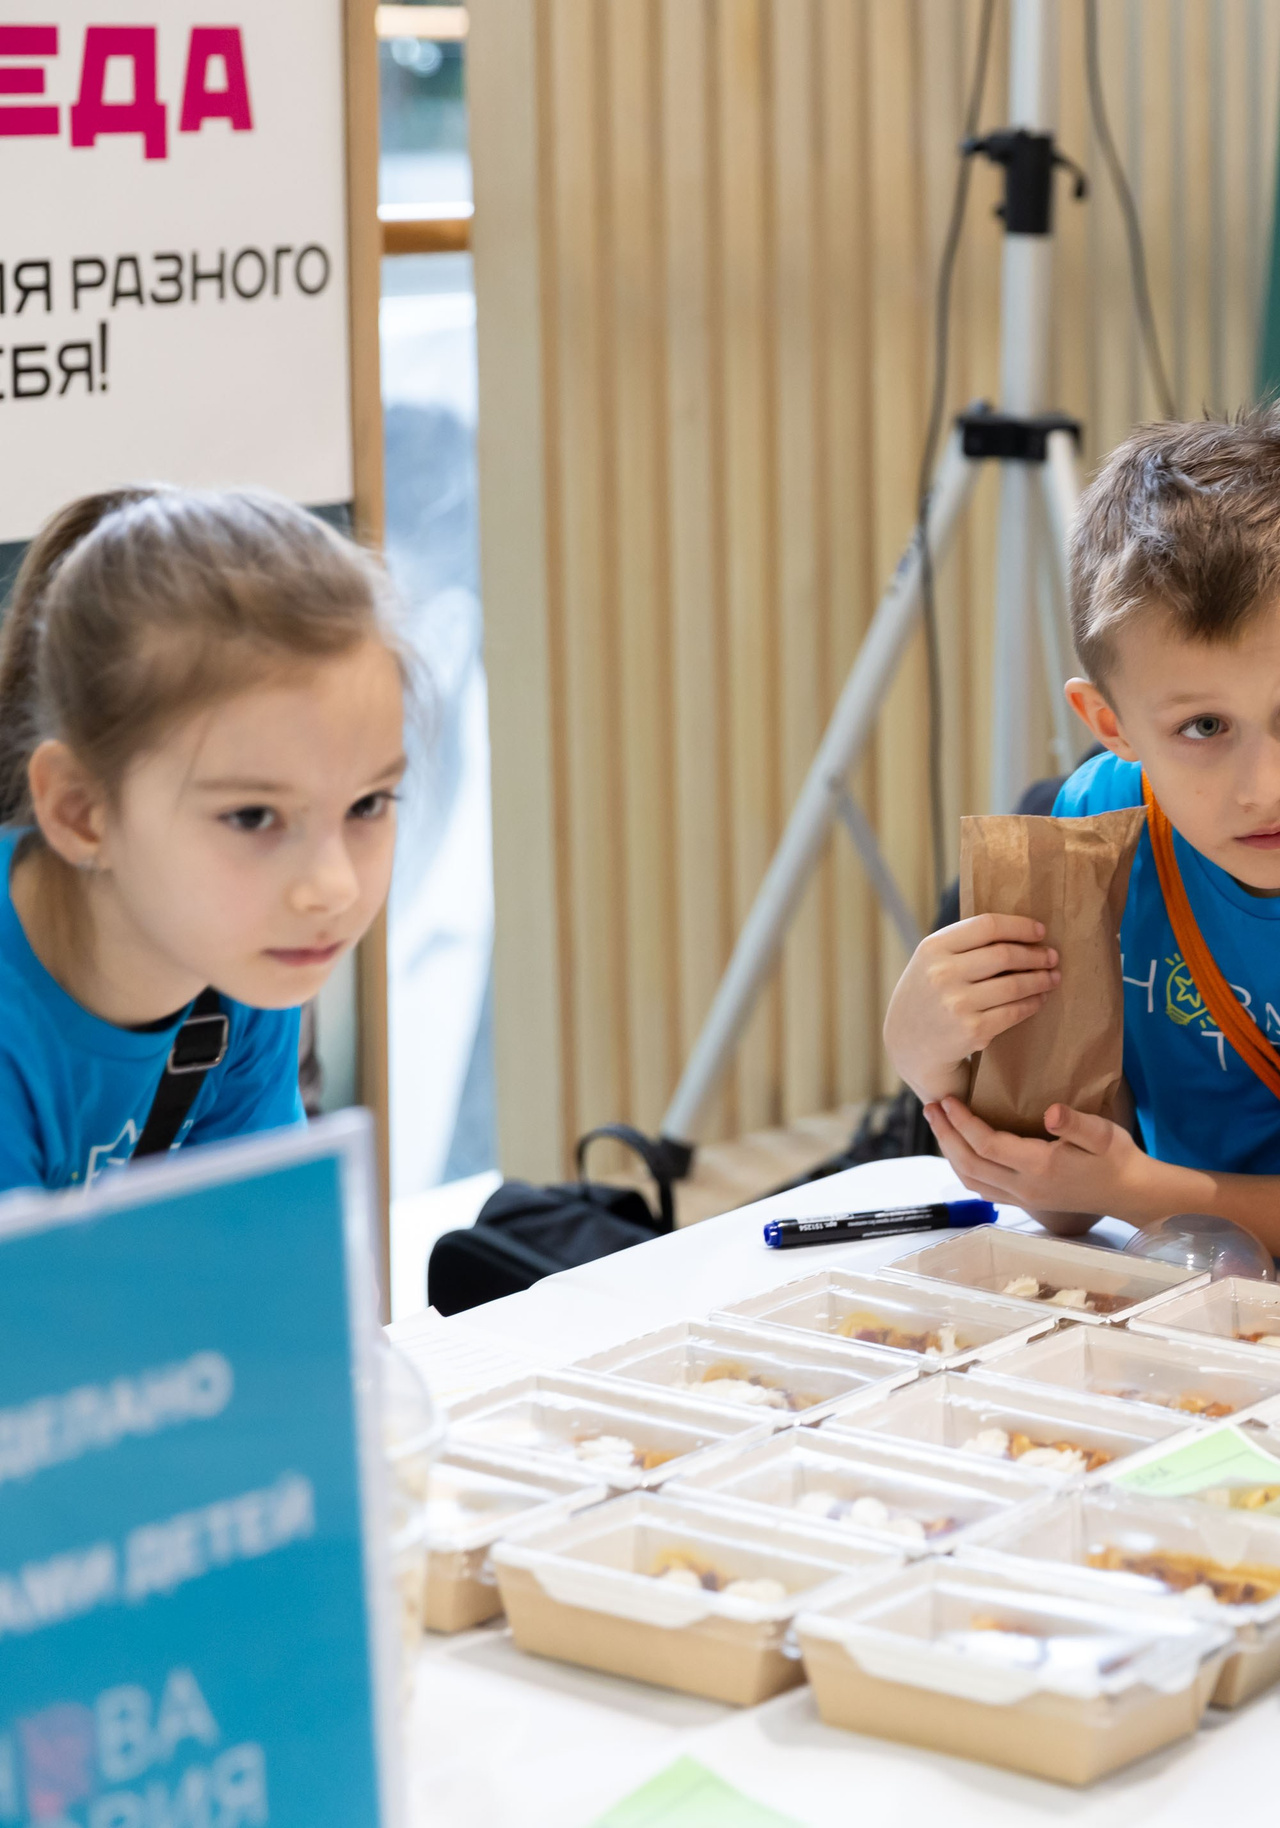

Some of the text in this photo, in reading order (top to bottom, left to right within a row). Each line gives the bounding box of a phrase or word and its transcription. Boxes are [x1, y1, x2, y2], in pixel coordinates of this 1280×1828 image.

[0, 243, 331, 317] Я РАЗНОГО
[0, 319, 108, 401] БЯ!
